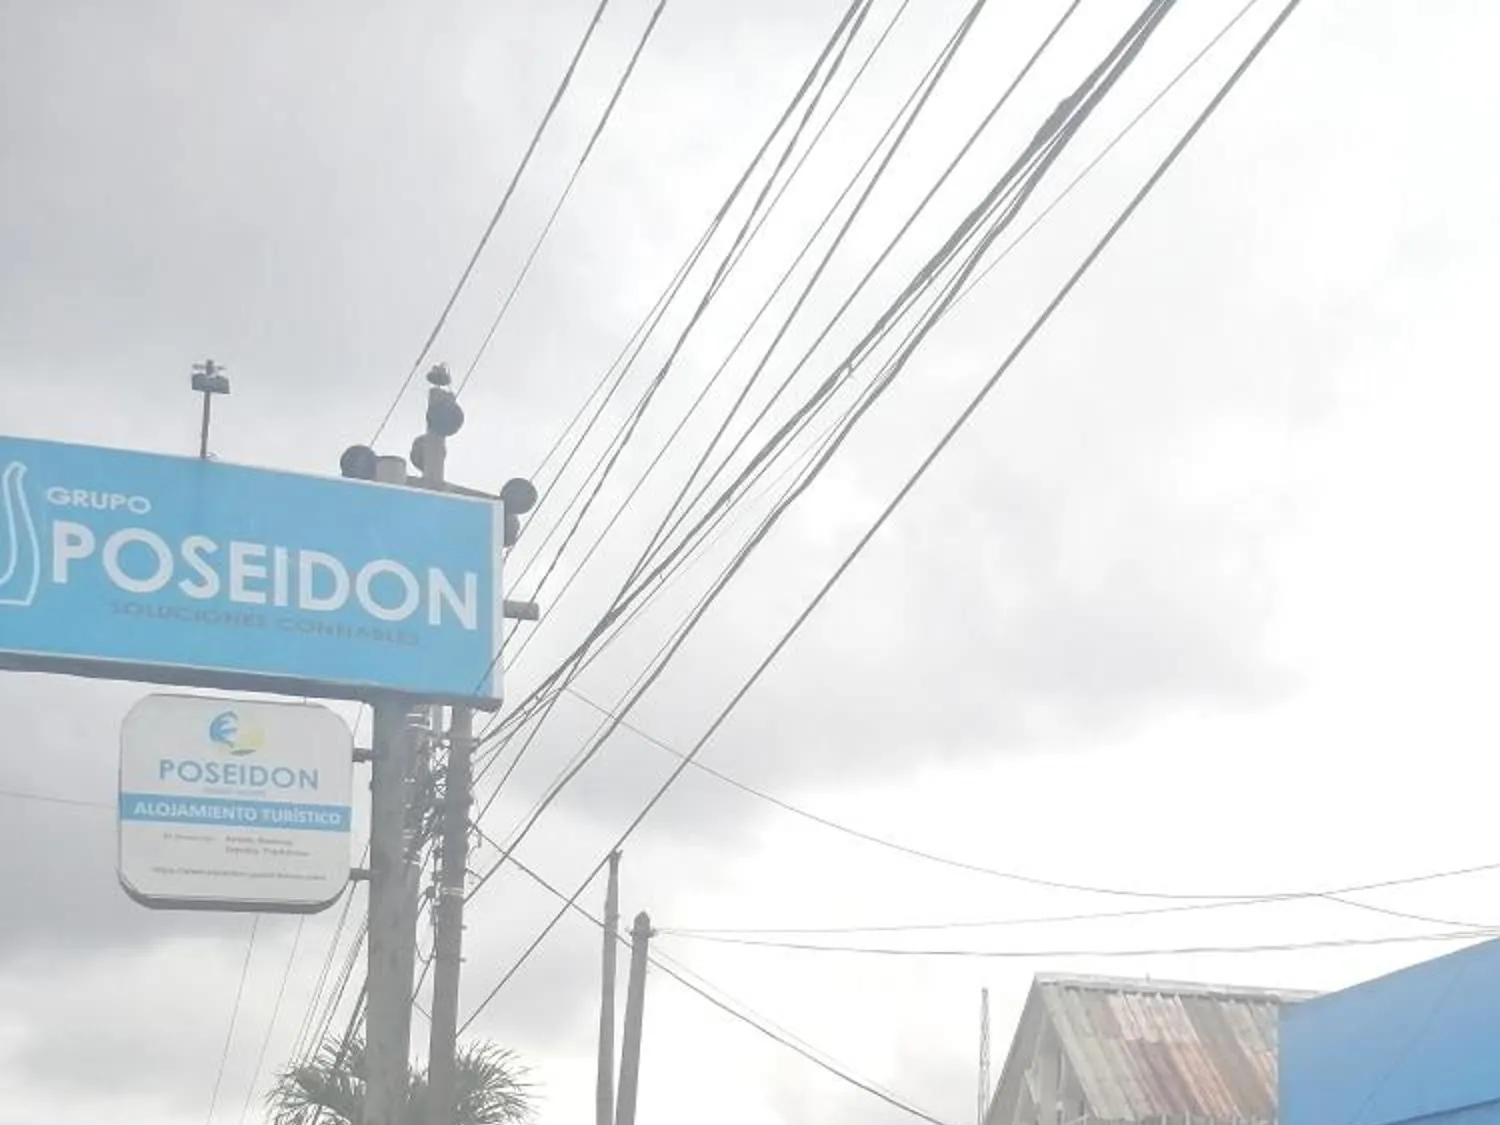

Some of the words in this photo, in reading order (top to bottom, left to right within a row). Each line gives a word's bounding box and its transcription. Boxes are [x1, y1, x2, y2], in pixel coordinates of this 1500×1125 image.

[46, 485, 153, 515] GRUPO
[51, 519, 479, 631] POSEIDON
[158, 758, 320, 791] POSEIDON
[134, 801, 258, 823] ALOJAMIENTO
[263, 806, 342, 825] TURÍSTICO
